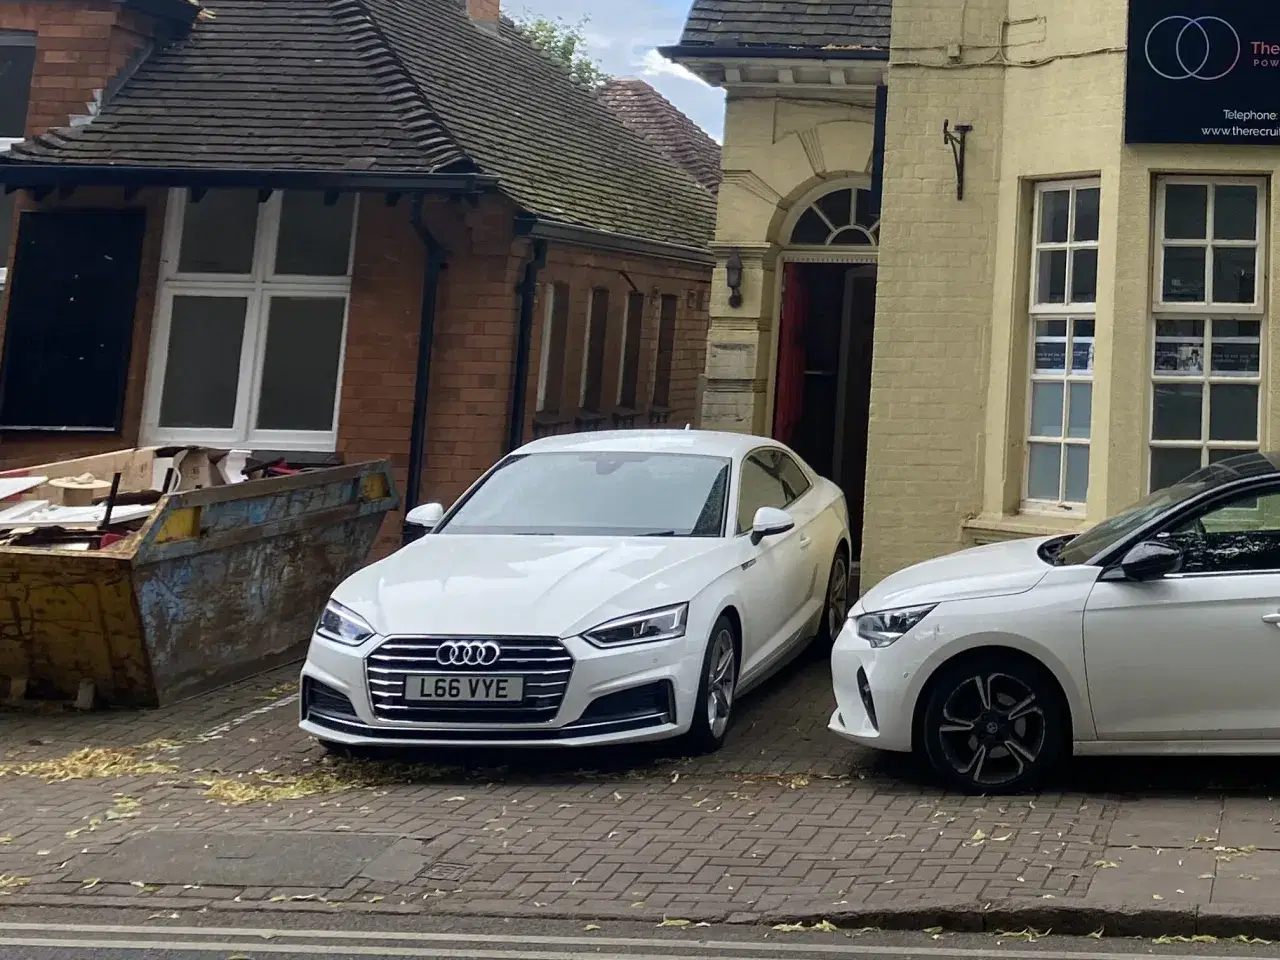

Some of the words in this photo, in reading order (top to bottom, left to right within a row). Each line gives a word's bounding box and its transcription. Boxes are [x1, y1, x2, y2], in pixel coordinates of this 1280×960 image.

[1250, 41, 1280, 55] The
[1223, 109, 1279, 122] Telephone:
[420, 678, 461, 698] L66
[467, 678, 509, 699] VYE
